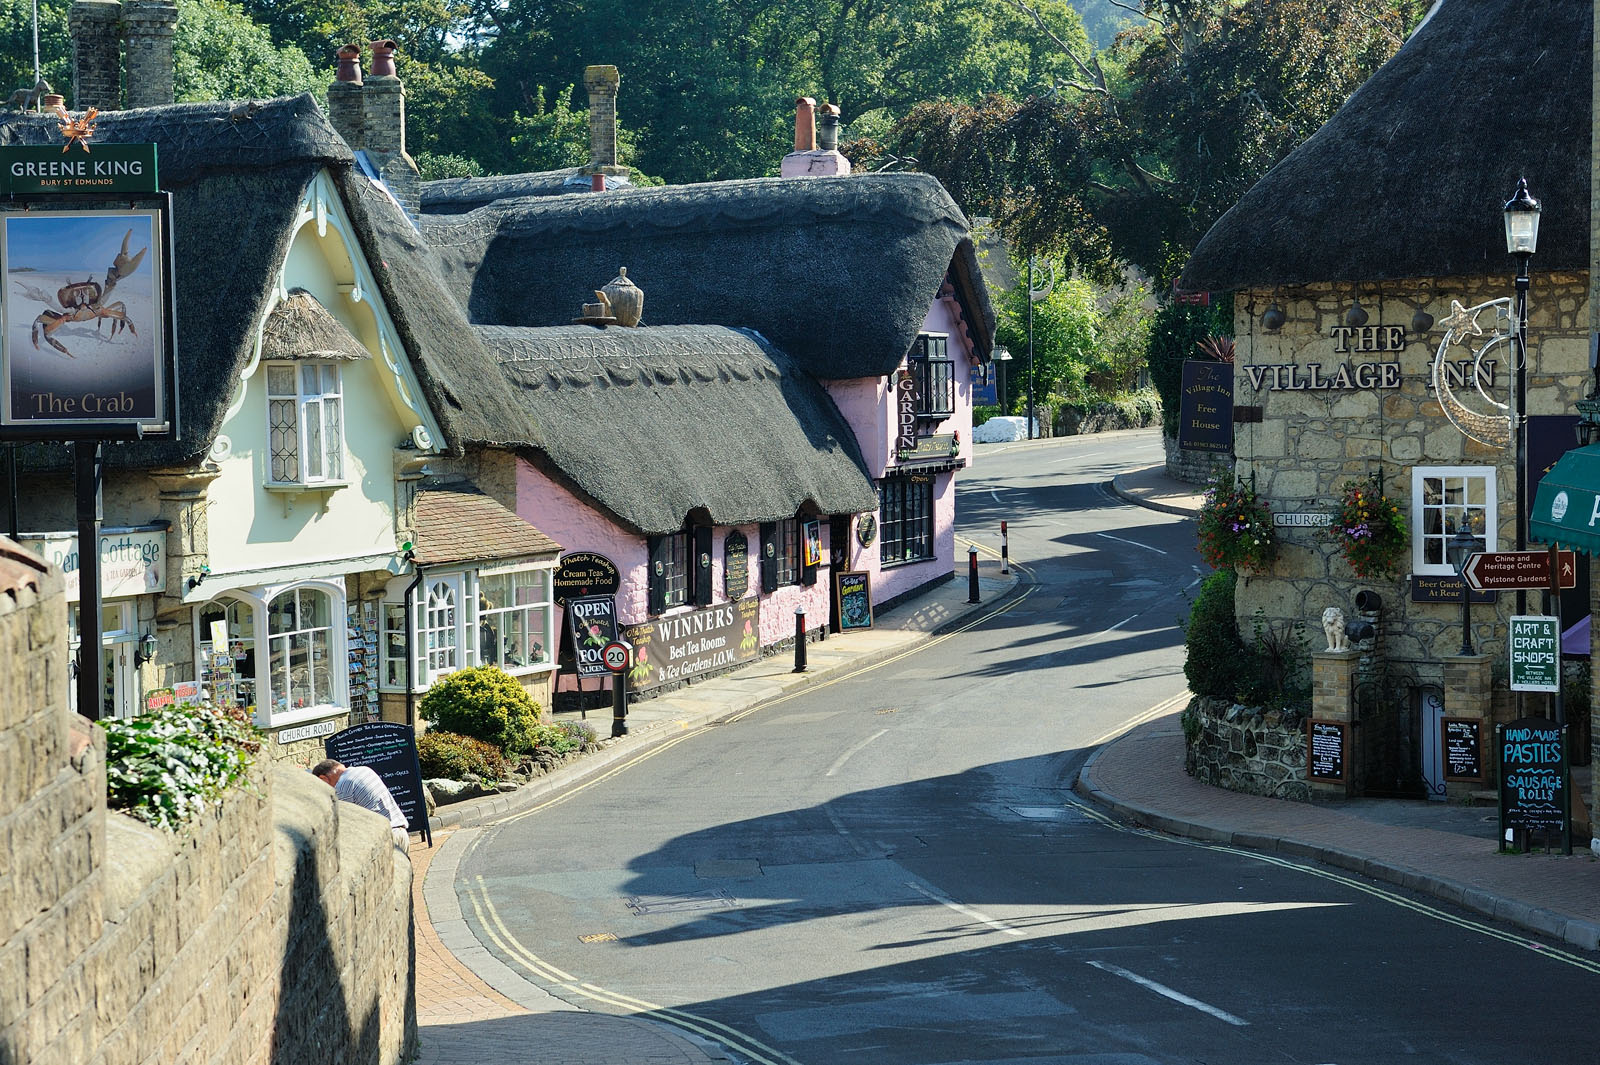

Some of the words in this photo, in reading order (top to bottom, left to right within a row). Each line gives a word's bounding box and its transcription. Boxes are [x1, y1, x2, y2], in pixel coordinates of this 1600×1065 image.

[11, 161, 87, 176] GREENE
[94, 160, 143, 175] KING
[75, 178, 113, 186] EDMUNDS
[1330, 325, 1405, 353] THE
[1197, 366, 1220, 381] The
[1242, 362, 1400, 391] VILLAGE
[1185, 384, 1215, 395] Village
[1217, 384, 1231, 398] Inn
[31, 392, 76, 413] The
[81, 391, 134, 413] Crab
[1197, 403, 1217, 414] Free
[900, 379, 915, 448] GARDEN
[1191, 419, 1220, 430] House
[1276, 514, 1328, 525] CHURCH
[100, 536, 160, 568] Cottage
[563, 554, 590, 566] Thatch
[591, 555, 615, 575] Teashop
[1484, 563, 1515, 571] Heritage
[562, 569, 587, 578] Cream
[587, 568, 604, 577] Teas
[1484, 576, 1515, 584] Rylstone
[554, 577, 594, 587] Homemade
[595, 576, 613, 585] Food
[1418, 580, 1438, 589] Beer
[1440, 589, 1461, 597] Rear
[574, 602, 611, 617] OPEN
[626, 626, 640, 638] Old
[640, 624, 655, 635] Thatch
[658, 606, 734, 643] WINNERS
[1514, 623, 1540, 635] ART
[1543, 623, 1551, 635] &
[669, 645, 686, 661] Best
[687, 639, 699, 656] Tea
[700, 635, 726, 651] Rooms
[1514, 637, 1554, 649] CRAFT
[580, 648, 603, 663] FOO
[608, 651, 625, 662] 20
[1514, 652, 1554, 664] SHOPS
[659, 667, 666, 682] &
[666, 664, 680, 680] Tea
[681, 658, 712, 676] Gardens
[712, 648, 736, 666] I.O.W.
[148, 695, 174, 709] ANIMAL
[282, 727, 310, 741] CHURCH
[313, 722, 333, 735] ROAD
[1504, 742, 1561, 763] PASTIES
[1506, 775, 1562, 791] SAUSAGE
[1518, 788, 1554, 801] ROLLS
